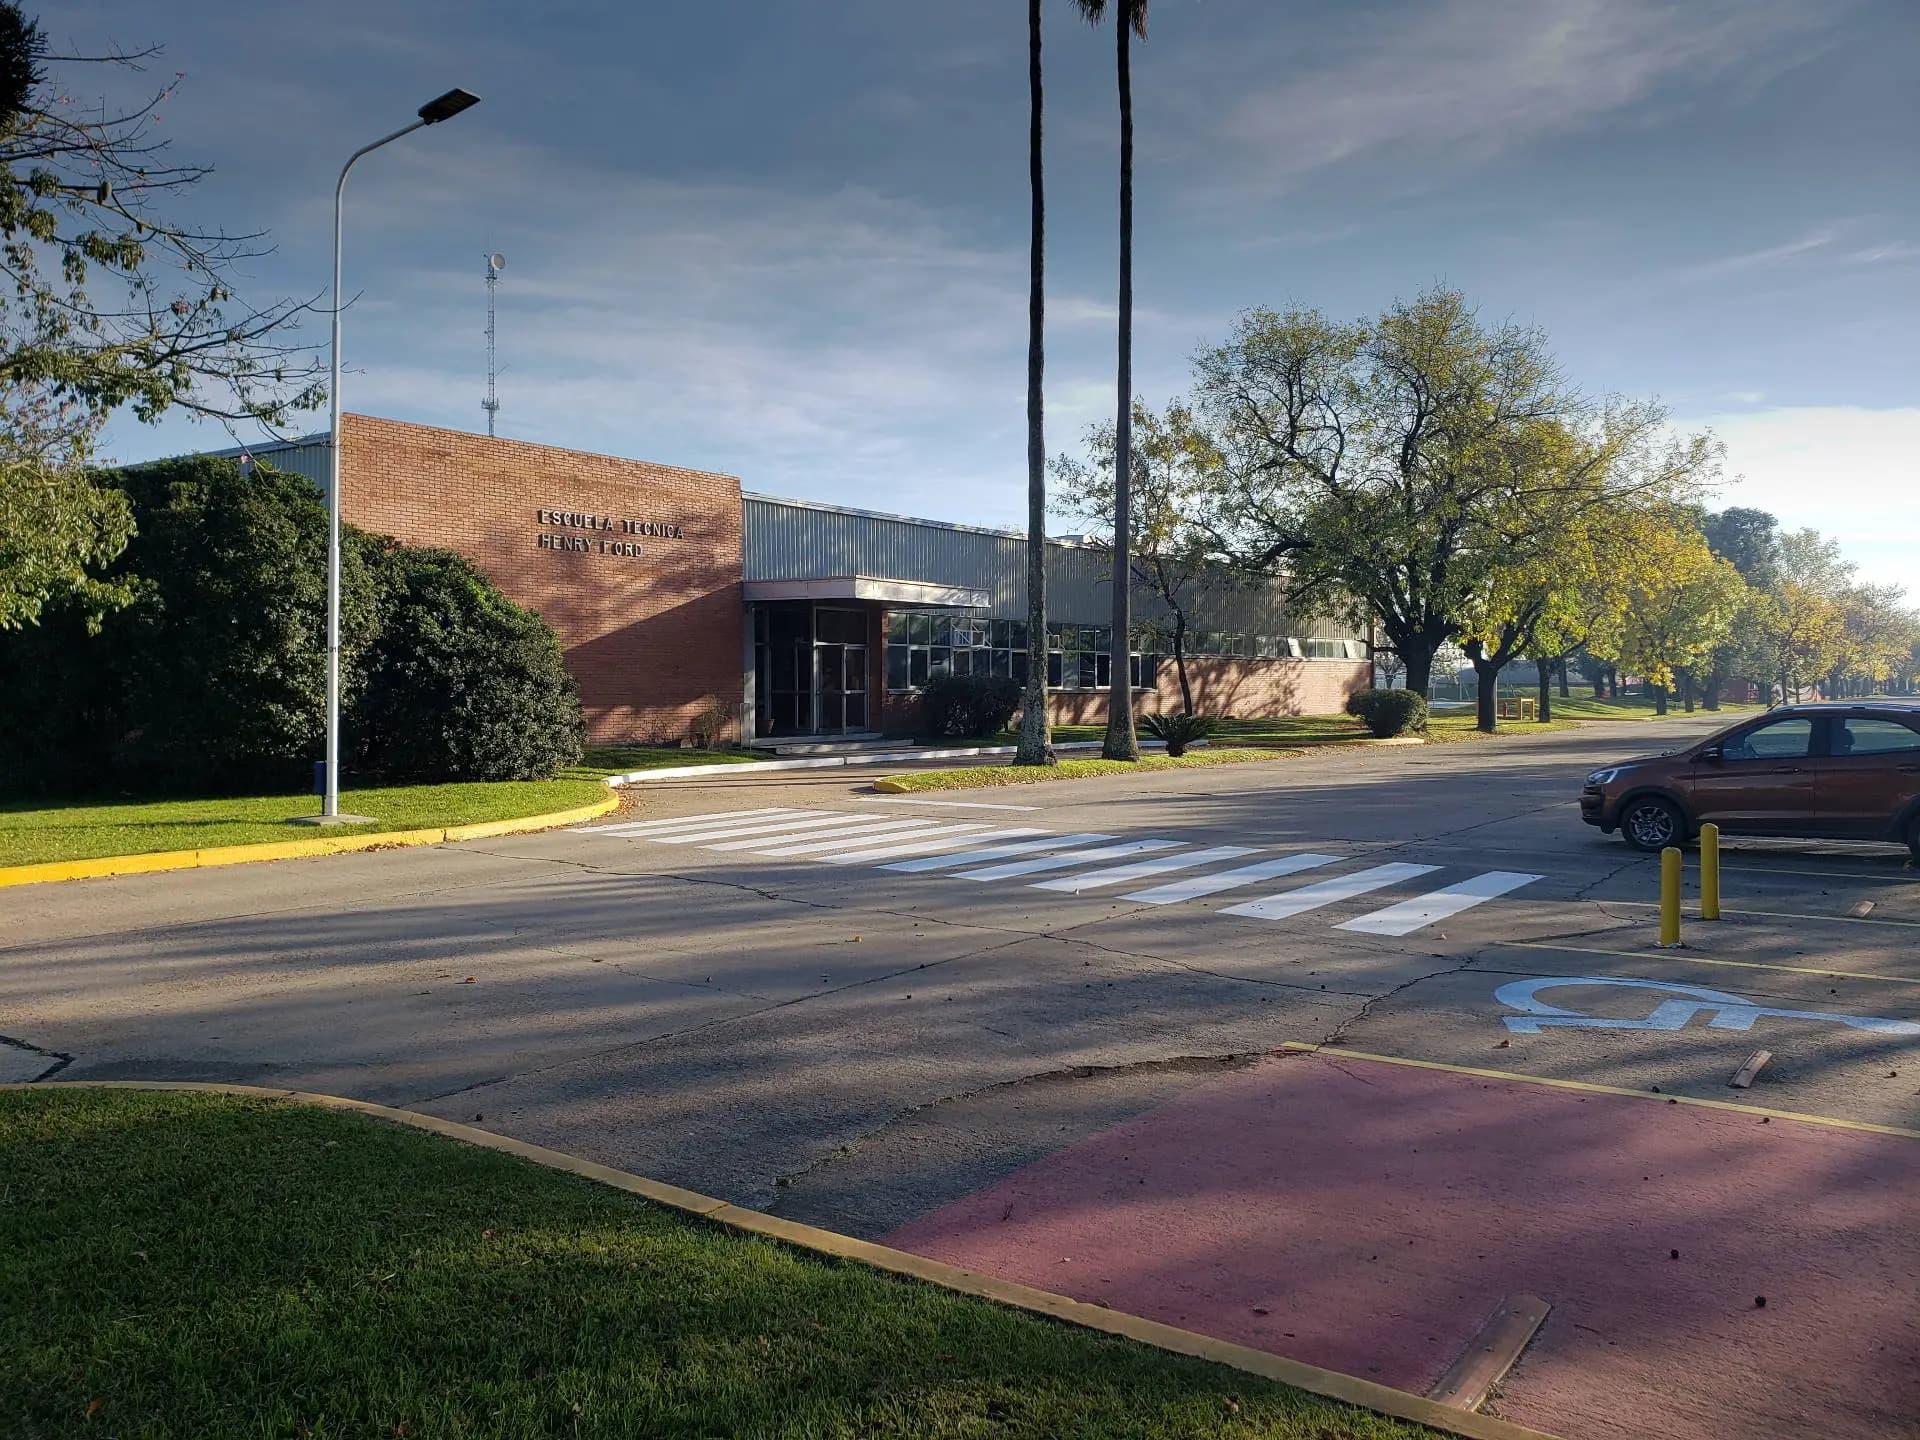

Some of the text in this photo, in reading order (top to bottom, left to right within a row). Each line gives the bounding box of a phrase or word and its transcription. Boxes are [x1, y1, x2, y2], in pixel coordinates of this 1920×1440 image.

[540, 509, 685, 539] ESCUELA TECNICA
[540, 533, 644, 557] HENRY FORD
